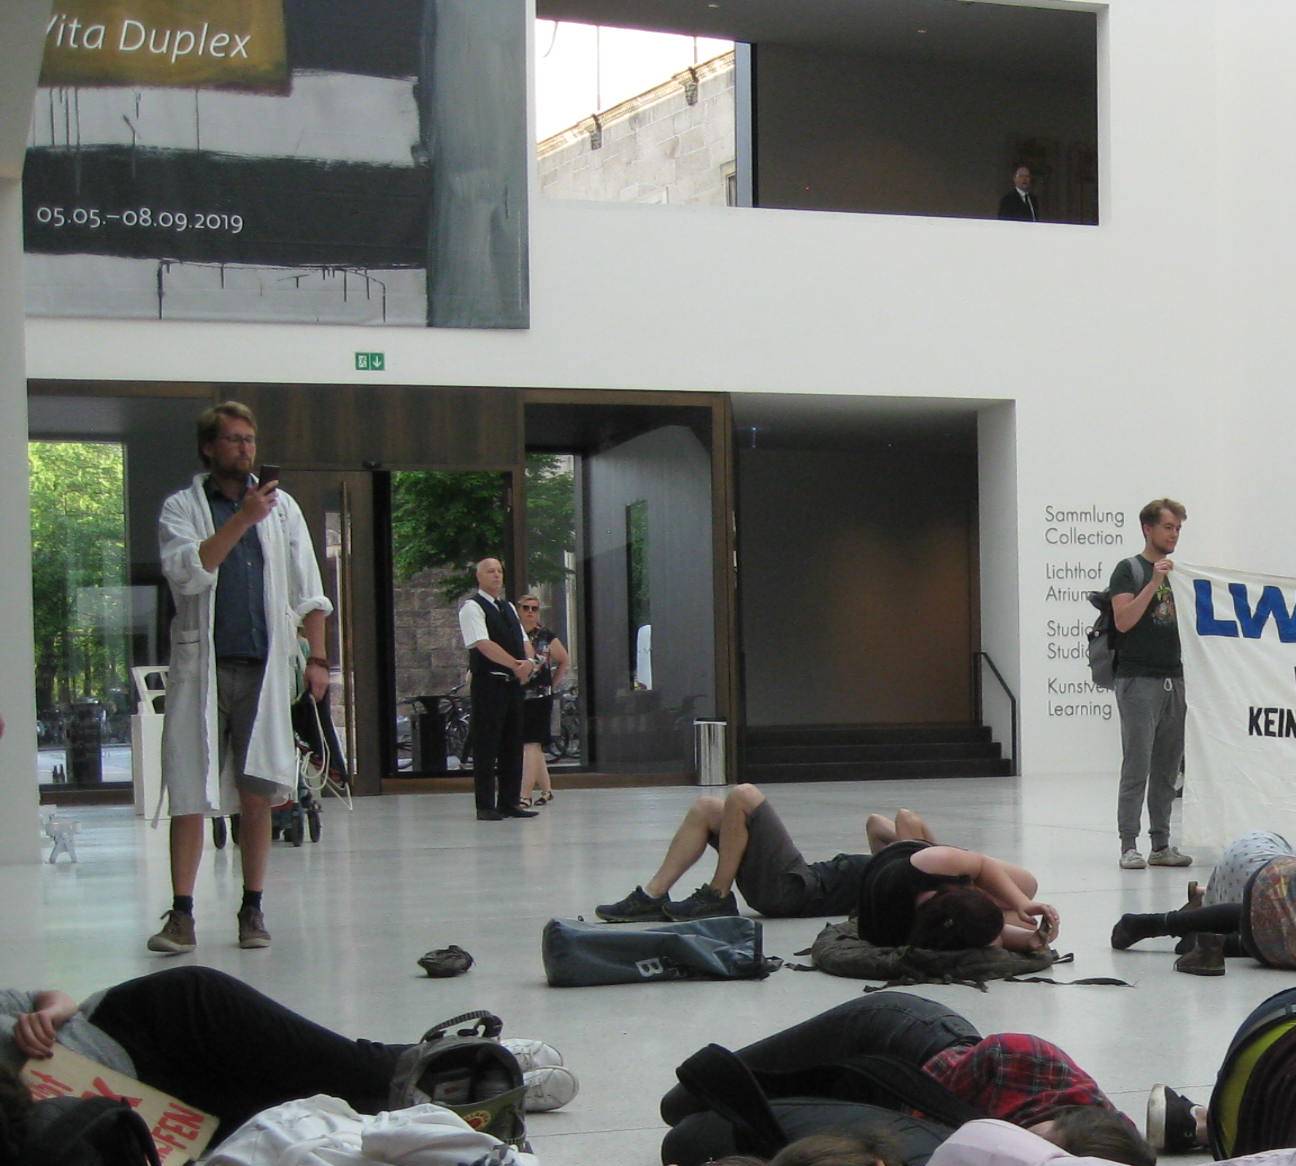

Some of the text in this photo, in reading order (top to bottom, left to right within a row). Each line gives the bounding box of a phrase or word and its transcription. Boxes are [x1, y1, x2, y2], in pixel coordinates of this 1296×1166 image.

[119, 19, 252, 64] Duplex
[1045, 505, 1125, 528] Sammlung
[1045, 527, 1123, 545] Collection
[1046, 562, 1102, 580] Lichthof
[1048, 700, 1112, 720] Learning
